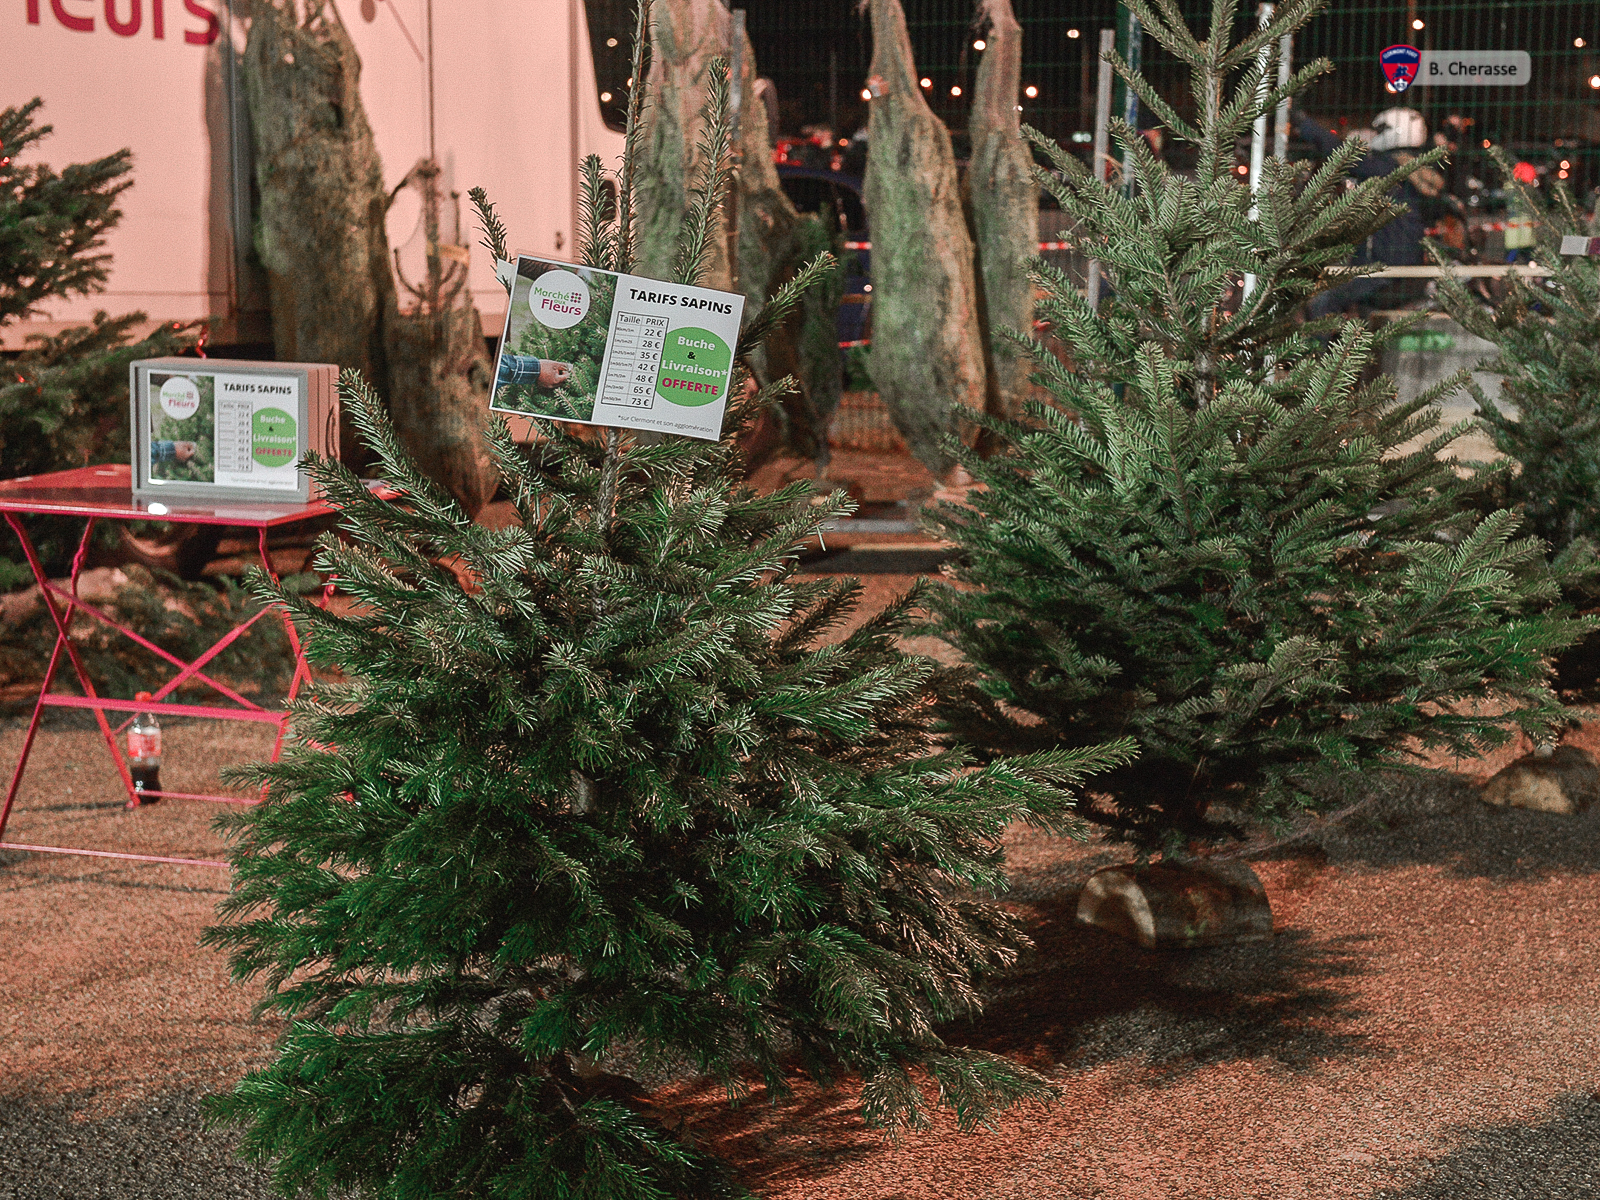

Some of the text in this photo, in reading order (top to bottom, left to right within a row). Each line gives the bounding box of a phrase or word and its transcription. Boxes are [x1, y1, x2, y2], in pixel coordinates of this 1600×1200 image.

[534, 287, 569, 301] Marché
[630, 289, 732, 314] TARIFS SAPINS
[541, 298, 582, 315] Fleurs
[620, 314, 665, 326] Taille PRIX
[644, 328, 655, 336] 22
[642, 340, 653, 348] 28
[677, 336, 716, 351] Buche
[687, 351, 696, 360] &
[638, 363, 648, 371] 42
[650, 364, 656, 372] €
[636, 375, 646, 383] 48
[224, 383, 292, 395] TARIFS SAPINS
[633, 386, 644, 394] 65
[646, 387, 651, 395] €
[662, 377, 719, 396] OFFERTE
[631, 397, 642, 406] 73
[260, 415, 286, 424] Buche
[630, 416, 656, 424] Clermont
